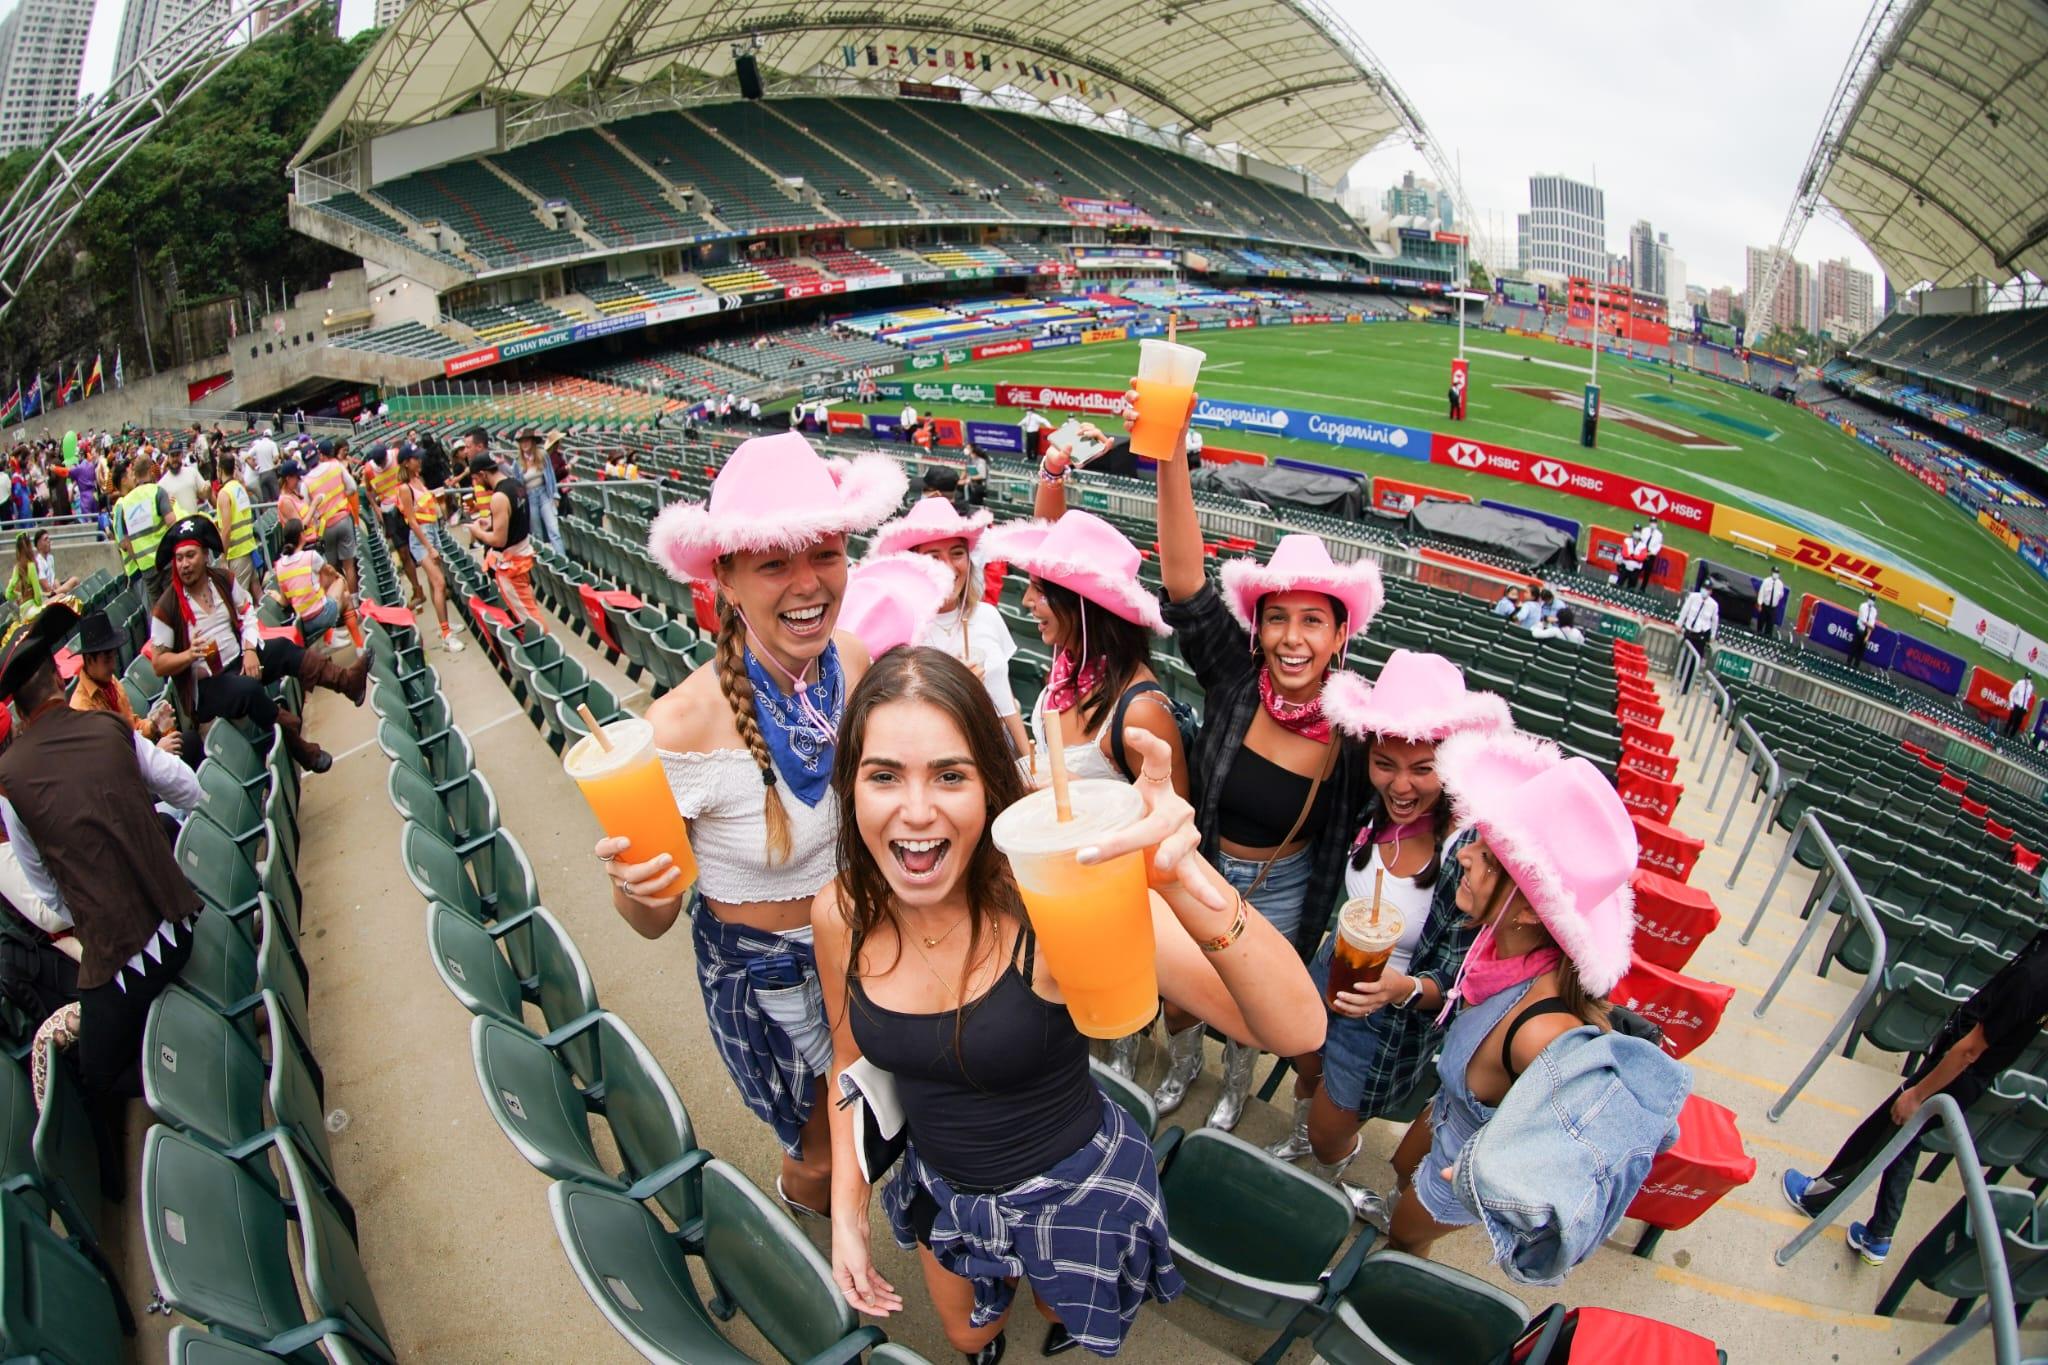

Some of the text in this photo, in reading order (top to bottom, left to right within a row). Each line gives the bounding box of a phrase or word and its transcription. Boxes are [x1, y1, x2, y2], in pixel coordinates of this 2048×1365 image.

[503, 332, 569, 356] CATHAY PACIFIC
[1092, 330, 1118, 341] DHL
[451, 352, 494, 371] hksevens.com
[1039, 388, 1133, 415] @WorldRugb
[1199, 401, 1272, 426] Capgemini
[1308, 415, 1389, 443] Capgemini
[1487, 454, 1520, 471] HSBC
[1571, 474, 1603, 492] HSBC
[1670, 501, 1702, 520] HSBC
[1989, 520, 2008, 539] DHL
[1793, 538, 1884, 592] DHL
[1827, 622, 1880, 653] @hksns
